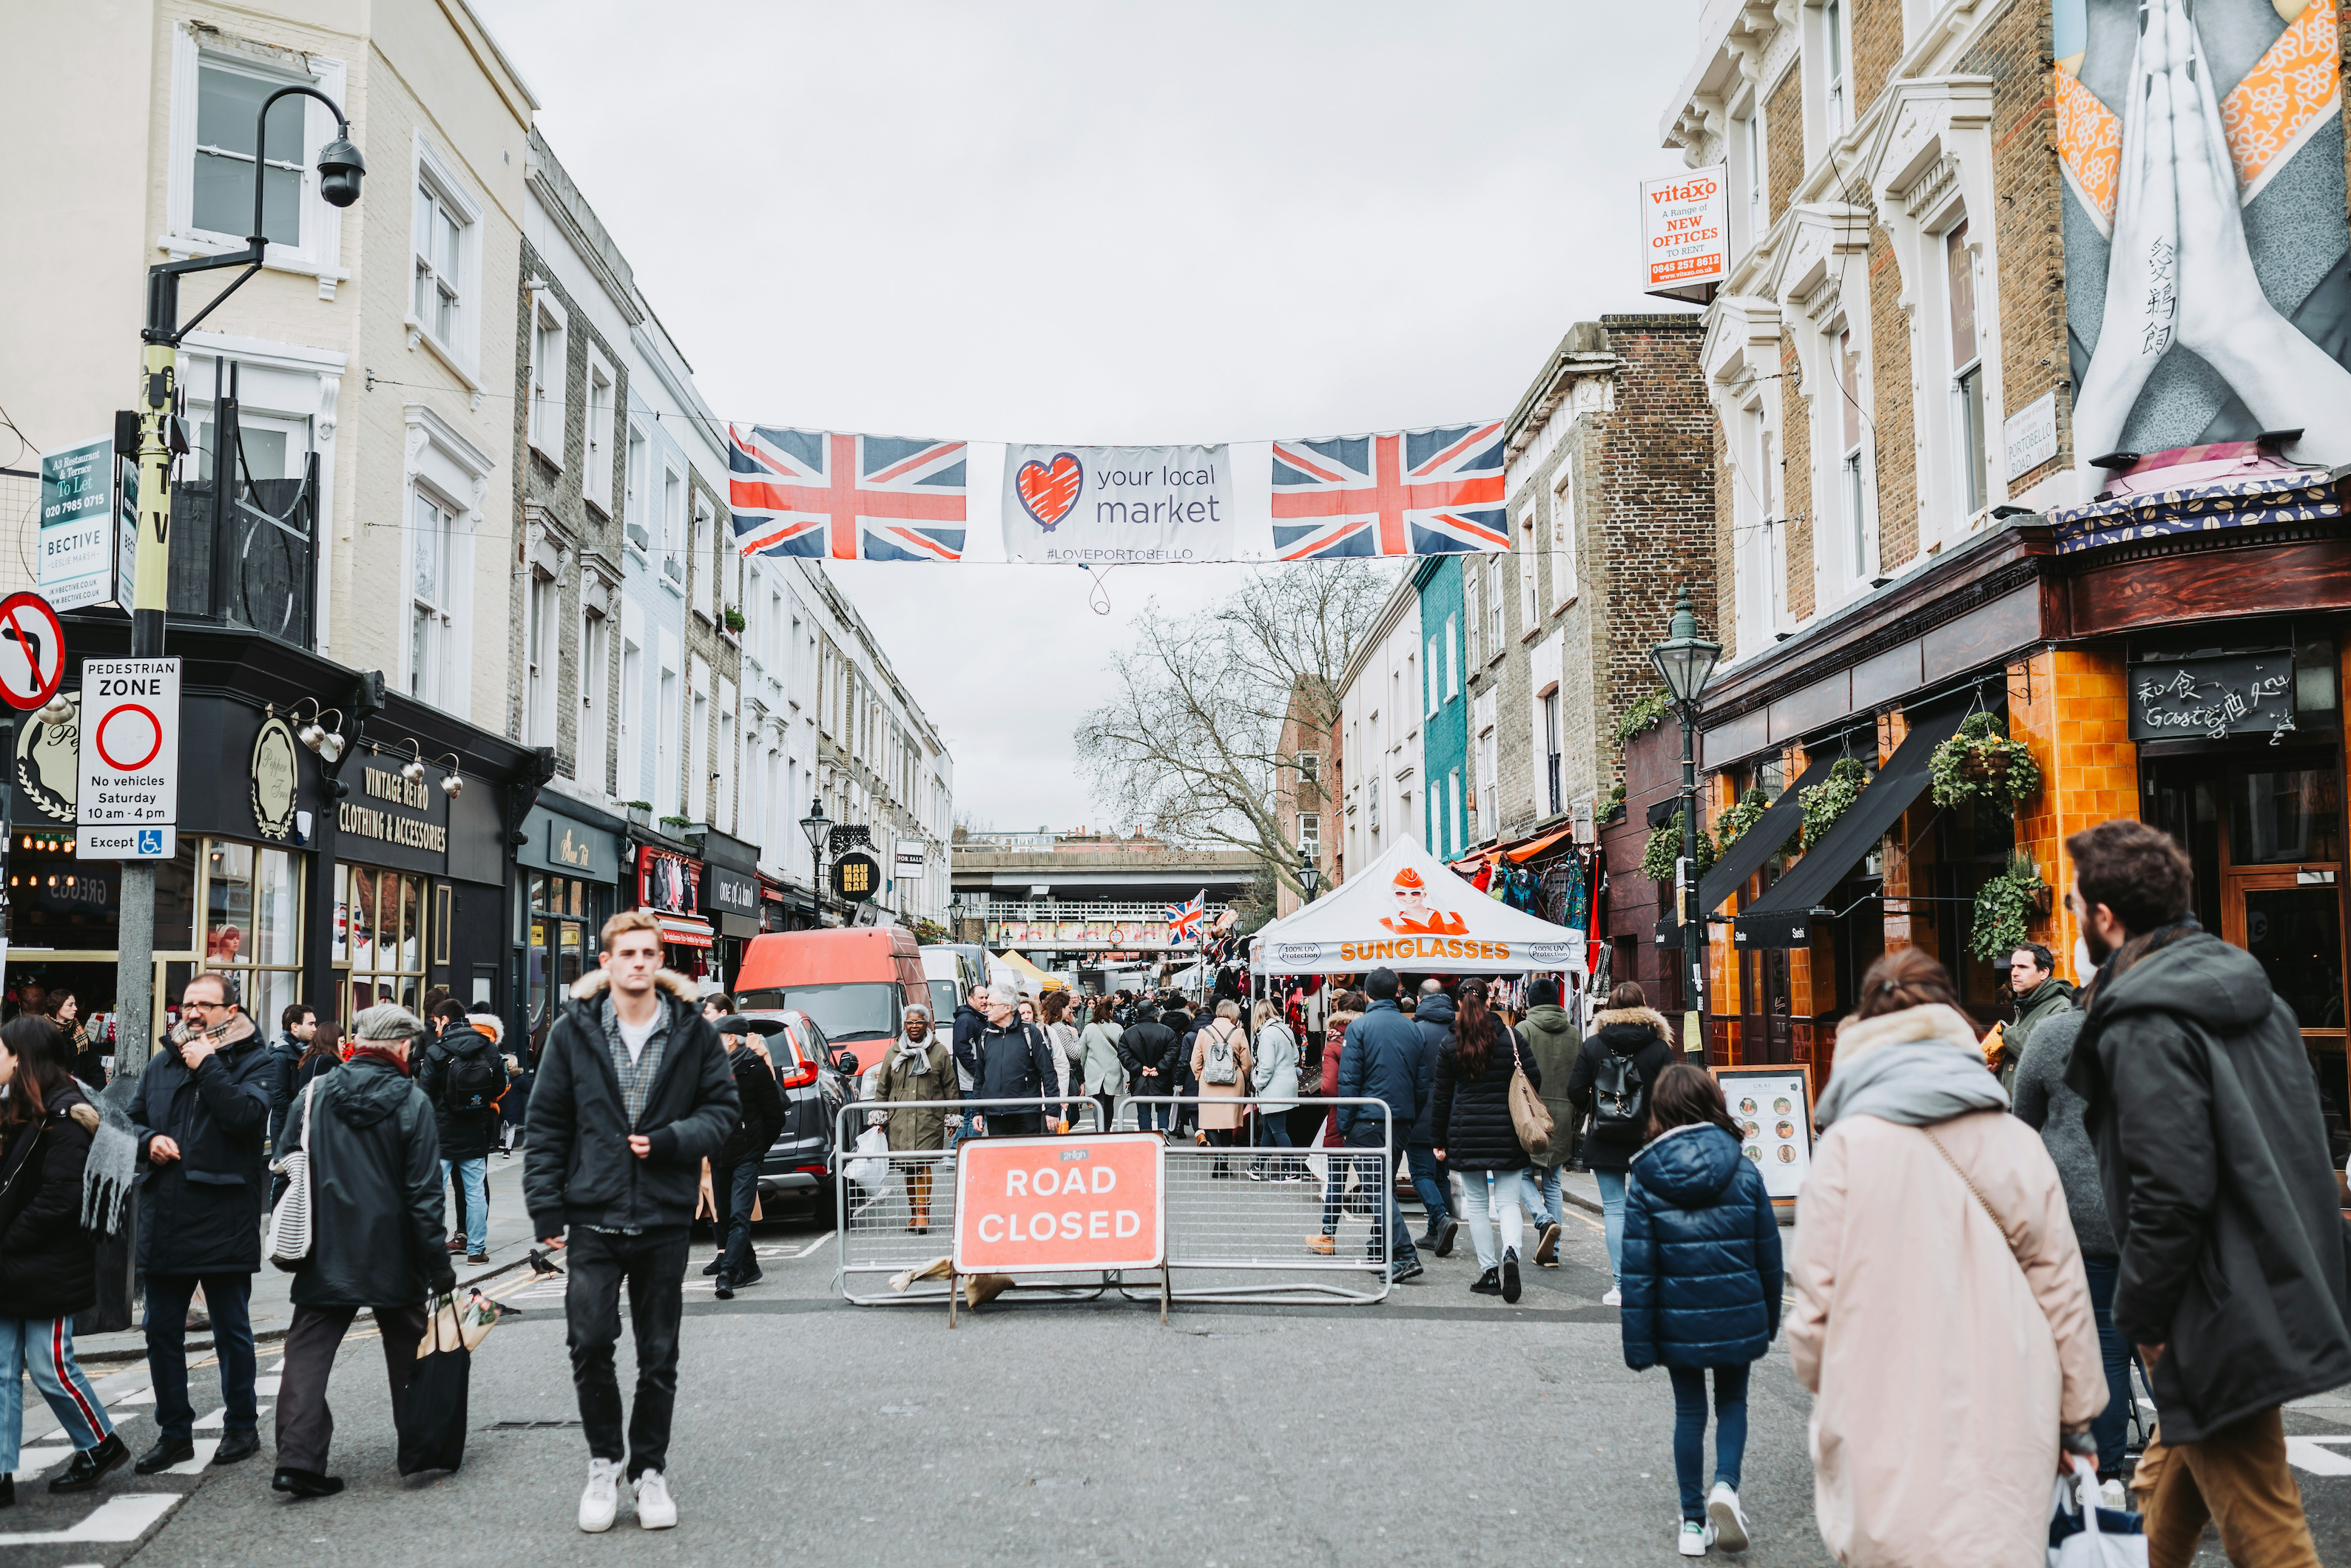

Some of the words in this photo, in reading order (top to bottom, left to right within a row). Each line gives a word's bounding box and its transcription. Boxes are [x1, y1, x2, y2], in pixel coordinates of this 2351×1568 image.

[1651, 180, 1717, 204] vitaxo
[1670, 206, 1697, 218] Range
[1699, 203, 1707, 212] of
[1667, 215, 1703, 232] NEW
[1653, 227, 1718, 248] OFFICES
[1667, 249, 1679, 257] TO
[1682, 245, 1704, 255] RENT
[1652, 263, 1676, 274] 0845
[1678, 259, 1694, 271] 257
[1697, 255, 1719, 266] 8612
[1659, 266, 1713, 280] www.vitaxo.co.uk
[2008, 422, 2051, 460] PORTOBELLO
[53, 459, 62, 471] A3
[64, 450, 101, 467] Restaurant
[59, 469, 66, 480] &
[67, 464, 92, 478] Terrace
[1098, 470, 1153, 490] your
[1164, 464, 1215, 486] local
[57, 480, 70, 498] To
[73, 475, 93, 493] Let
[45, 504, 61, 518] 020
[61, 499, 82, 514] 7985
[84, 493, 104, 508] 0715
[1097, 494, 1220, 524] market
[48, 530, 101, 555] BECTIVE
[1047, 548, 1193, 561] #LOVEPORTOBELLO
[49, 579, 97, 596] JK@BECTIVE.CO.UK
[88, 663, 175, 675] PEDESTRIAN
[99, 679, 161, 696] ZONE
[263, 747, 287, 777] Pepper
[92, 776, 109, 786] No
[114, 775, 164, 786] vehicles
[271, 779, 289, 801] Tree
[365, 766, 402, 804] VINTAGE
[403, 779, 429, 811] RETRO
[98, 792, 156, 805] Saturday
[88, 808, 103, 819] 10
[134, 808, 143, 818] 4
[146, 810, 165, 820] pm
[339, 802, 384, 840] CLOTHING
[386, 814, 393, 842] &
[394, 816, 446, 854] ACCESSORIES
[91, 837, 134, 849] Except
[560, 829, 578, 864] Blue
[579, 844, 589, 866] Tit
[843, 864, 868, 873] MAU
[843, 873, 868, 882] MAU
[720, 881, 732, 902] one
[732, 881, 739, 909] of
[738, 887, 742, 905] a
[742, 883, 754, 908] kind
[843, 882, 868, 892] BAR
[1792, 927, 1805, 939] Sushi
[1340, 938, 1510, 962] SUNGLASSES
[1063, 1149, 1086, 1161] 2high
[1006, 1166, 1116, 1197] ROAD
[978, 1209, 1141, 1243] CLOSED
